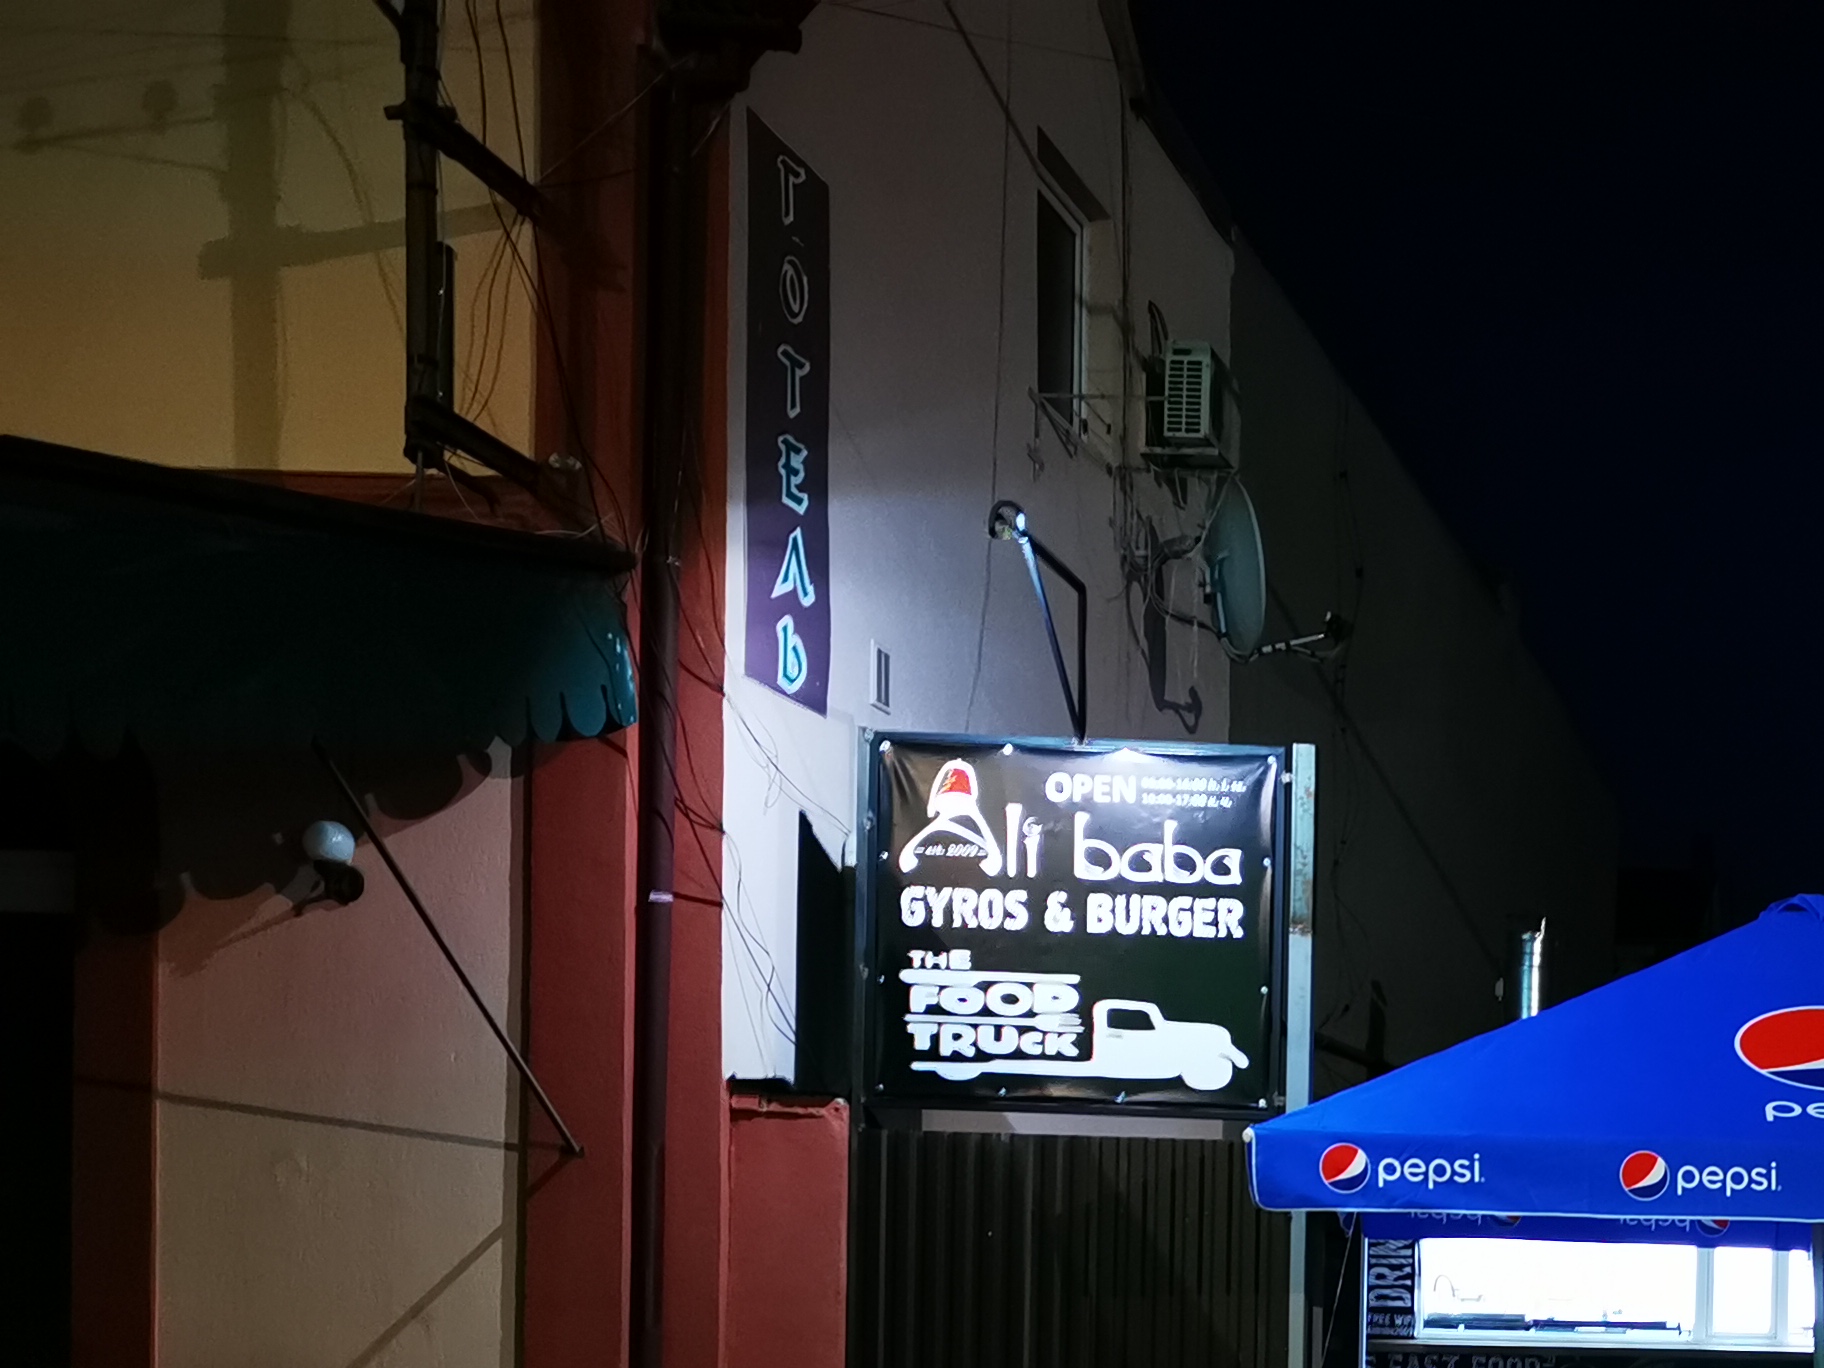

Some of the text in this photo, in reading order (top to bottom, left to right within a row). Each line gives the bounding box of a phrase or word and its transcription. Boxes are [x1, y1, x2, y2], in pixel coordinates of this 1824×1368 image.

[1045, 771, 1137, 804] OPEN
[899, 758, 1243, 885] Ali baba
[900, 886, 1244, 938] GYROS & BURGER
[908, 949, 971, 970] THE
[908, 982, 1079, 1015] FOOD
[907, 1022, 1079, 1057] TRUCK
[1377, 1153, 1483, 1190] pepsi
[1676, 1162, 1779, 1197] pepsi
[1368, 1239, 1413, 1308] DRIN
